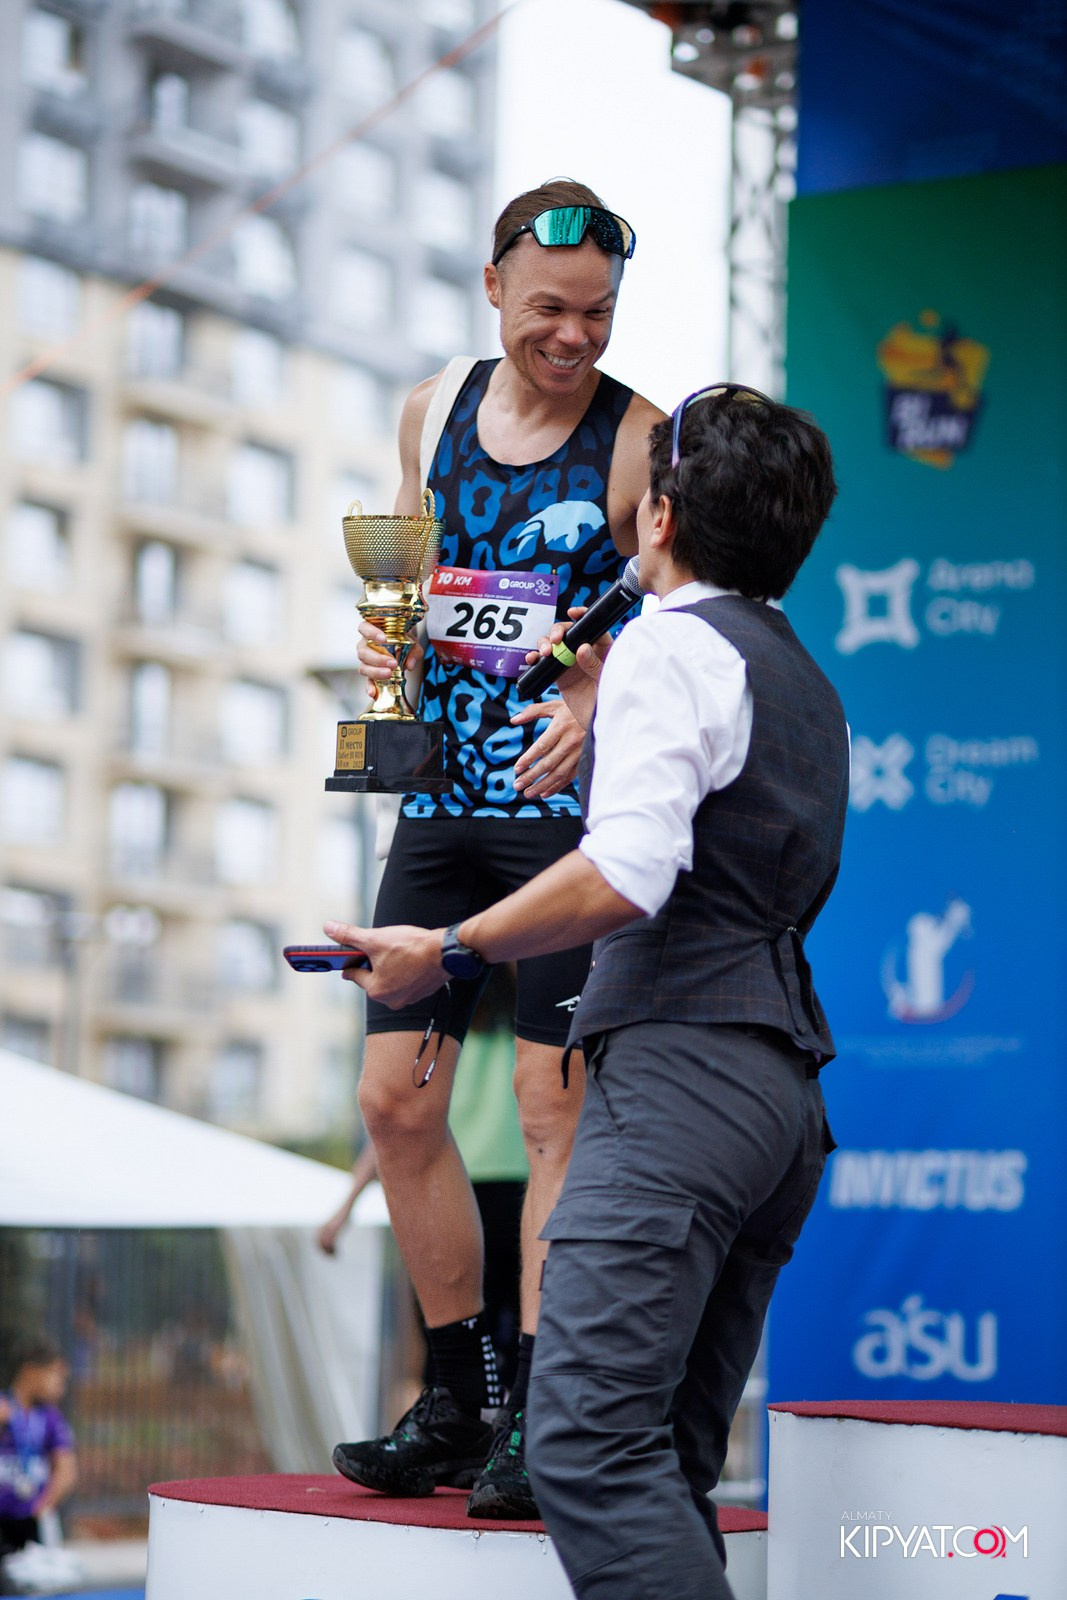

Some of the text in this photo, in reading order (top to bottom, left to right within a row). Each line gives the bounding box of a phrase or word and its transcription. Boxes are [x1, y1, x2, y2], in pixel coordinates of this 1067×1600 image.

[437, 572, 454, 585] 10
[509, 580, 535, 590] GROUP
[445, 601, 529, 642] 265
[829, 1149, 1027, 1211] INVICTUS
